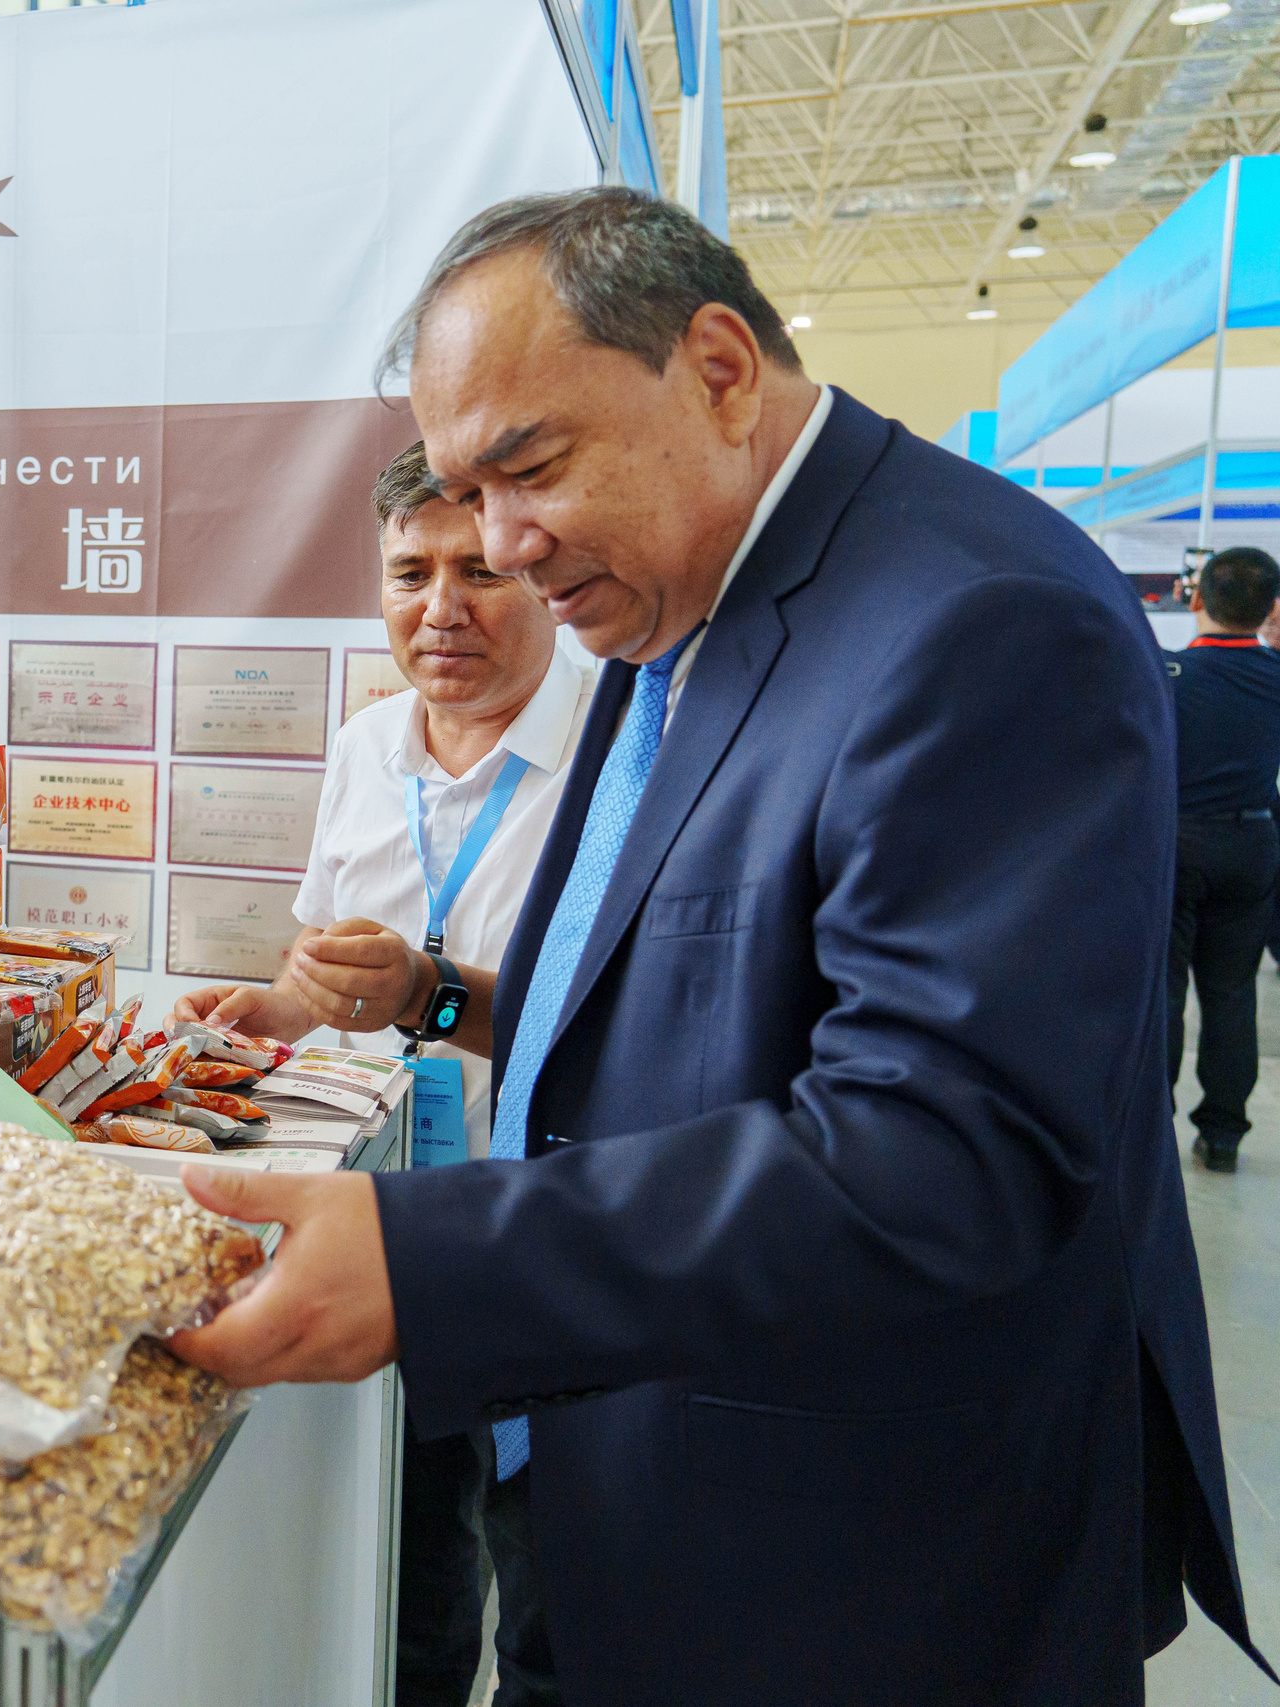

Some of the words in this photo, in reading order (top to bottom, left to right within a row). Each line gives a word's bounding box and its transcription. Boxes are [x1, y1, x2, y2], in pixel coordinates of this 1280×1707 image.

[38, 691, 128, 708] 示范企业
[33, 794, 131, 813] 企业技术中心
[27, 906, 129, 929] 模范职工小家
